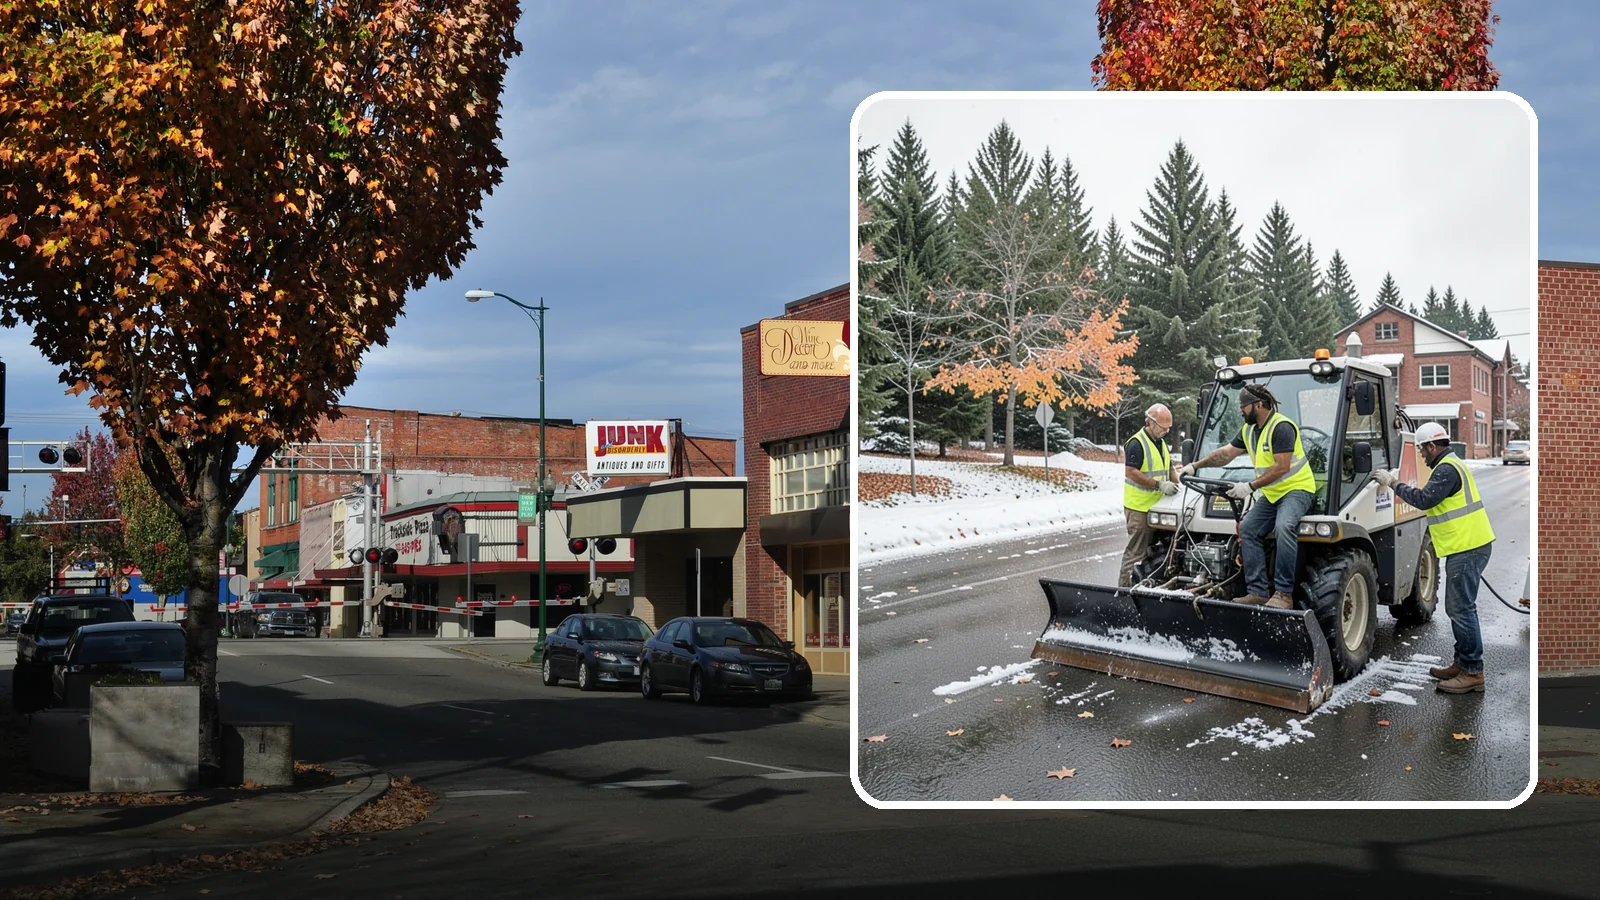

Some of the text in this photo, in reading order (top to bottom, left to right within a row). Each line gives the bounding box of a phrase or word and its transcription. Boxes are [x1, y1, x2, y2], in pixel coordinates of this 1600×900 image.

[764, 327, 831, 366] Decor
[596, 425, 664, 457] JUNK
[607, 446, 646, 454] DISORDERLY
[597, 461, 665, 470] ANTIQUES AND GIFTS
[414, 519, 429, 535] Pizza
